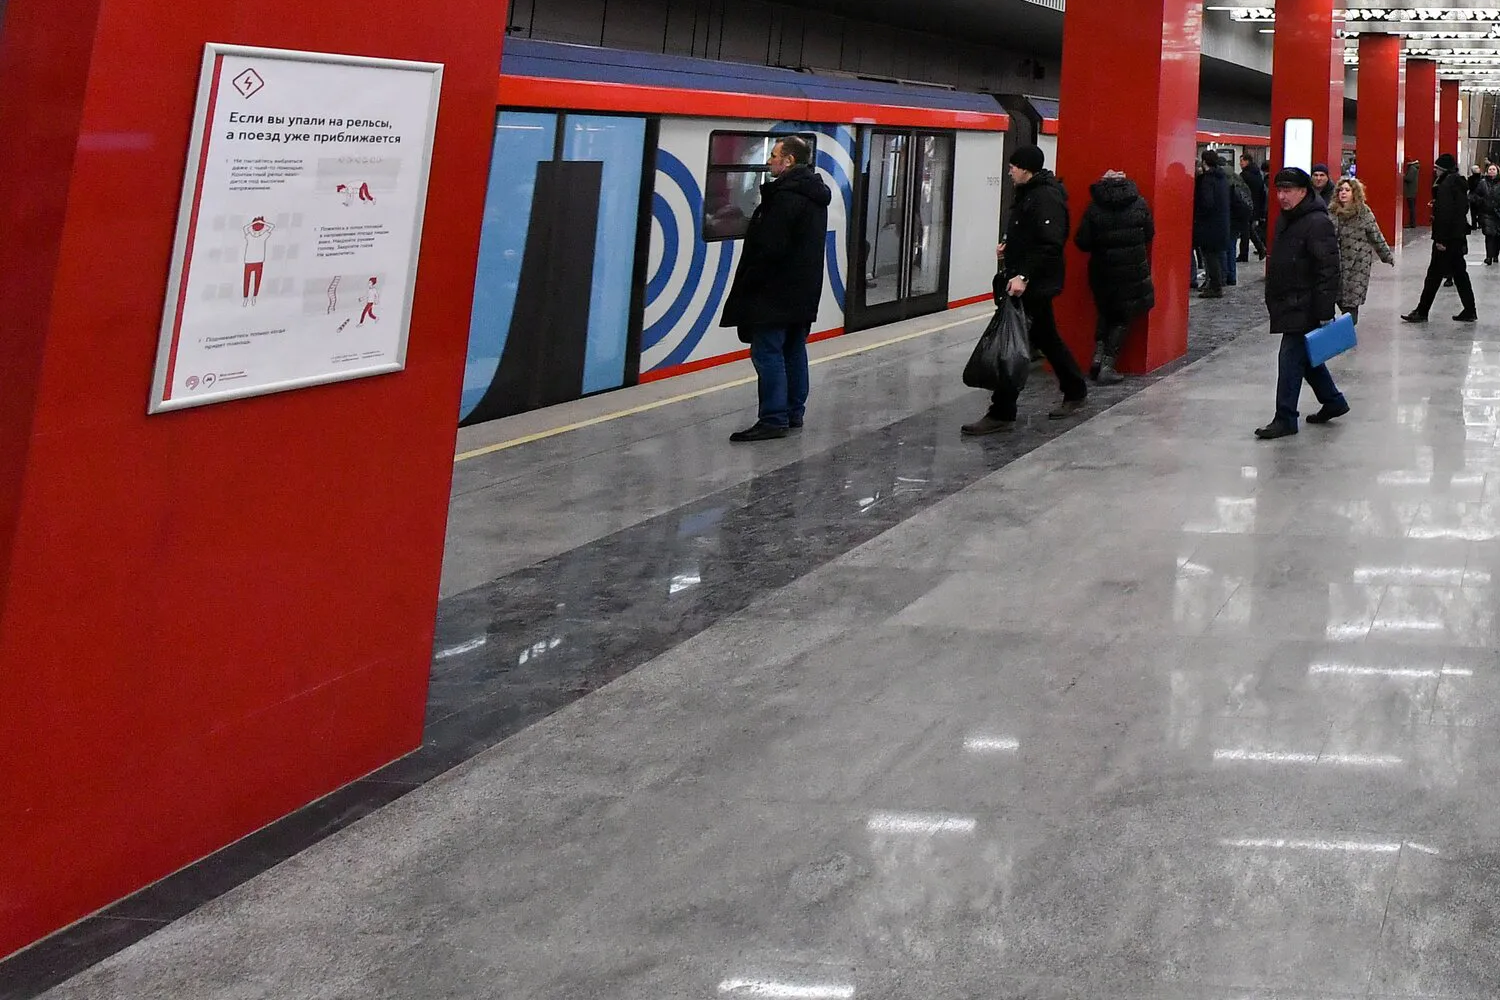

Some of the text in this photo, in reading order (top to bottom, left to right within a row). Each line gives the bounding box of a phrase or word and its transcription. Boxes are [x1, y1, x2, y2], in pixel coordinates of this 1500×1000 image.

[229, 112, 393, 129] Если вы упали на рельсы,
[226, 132, 401, 144] а поезд уже приближается
